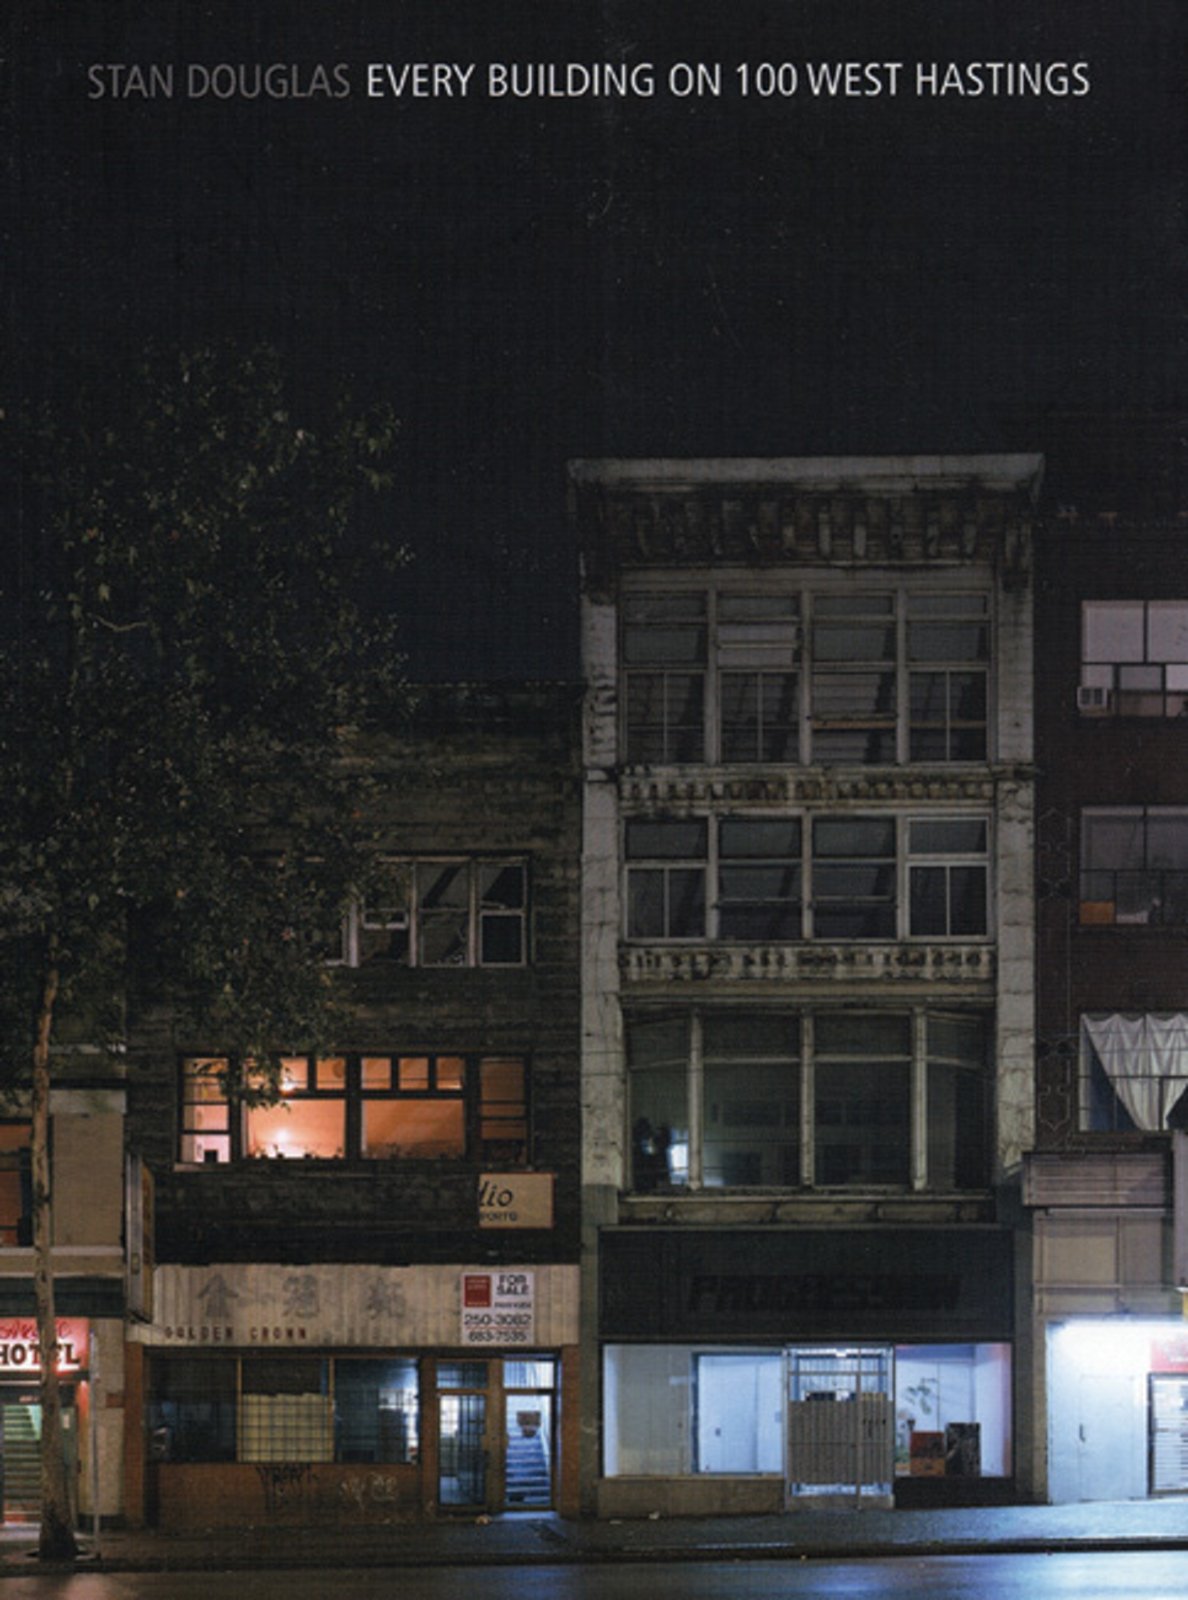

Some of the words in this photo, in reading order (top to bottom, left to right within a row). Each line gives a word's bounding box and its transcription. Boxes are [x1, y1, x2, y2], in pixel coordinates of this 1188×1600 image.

[499, 1274, 527, 1285] FOR
[496, 1284, 530, 1296] SALE
[0, 1343, 81, 1366] HOTL
